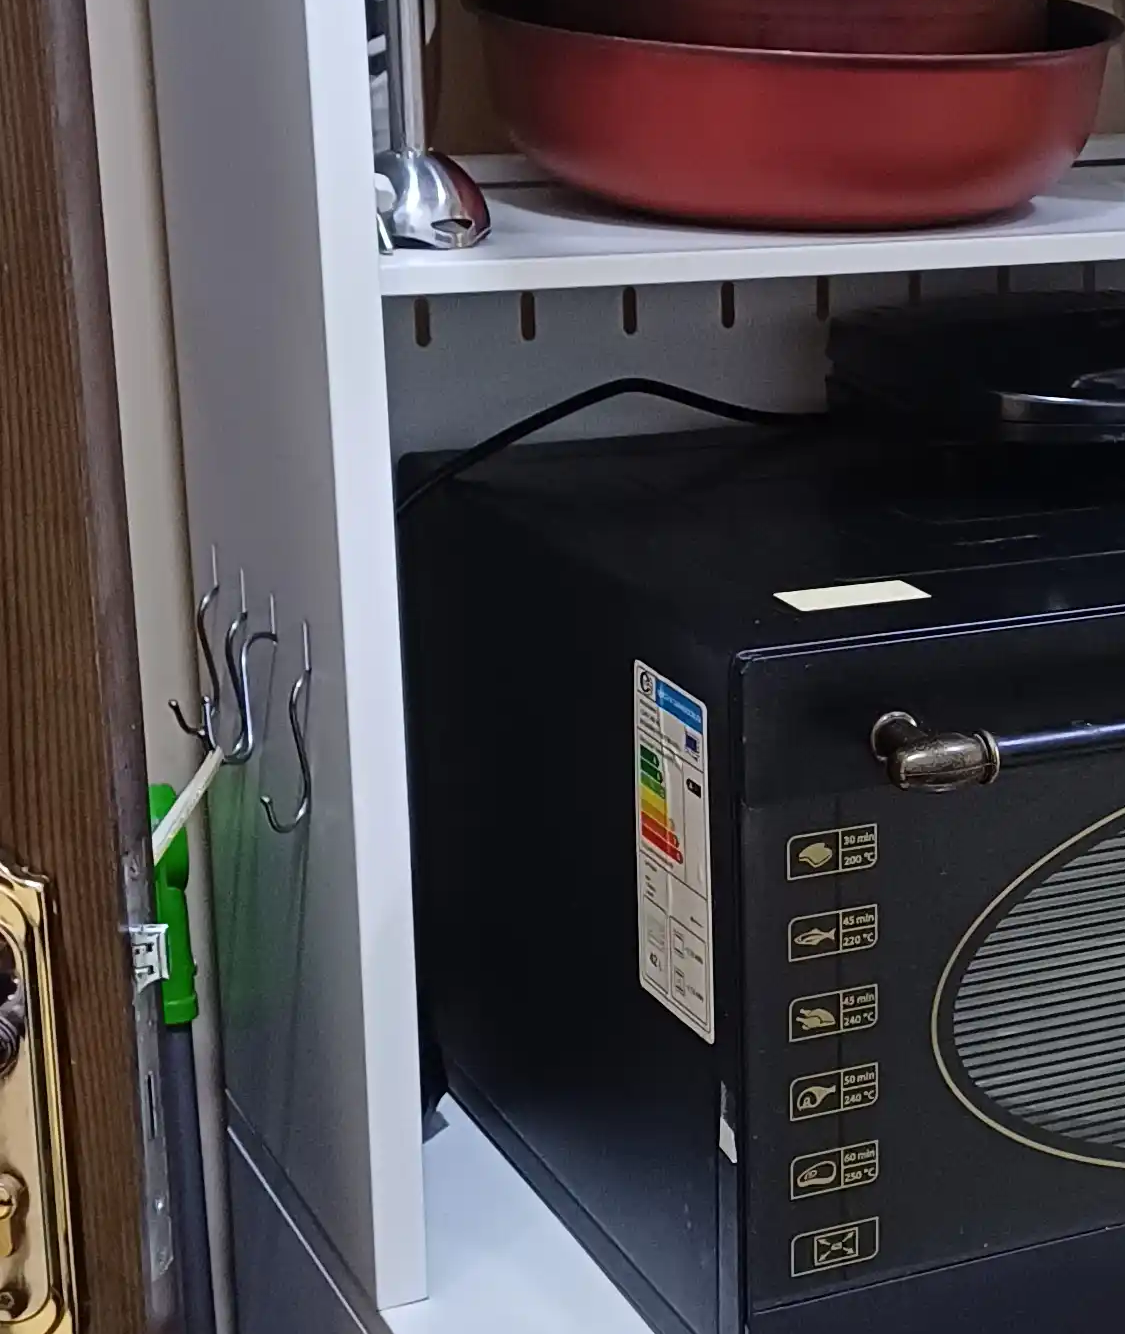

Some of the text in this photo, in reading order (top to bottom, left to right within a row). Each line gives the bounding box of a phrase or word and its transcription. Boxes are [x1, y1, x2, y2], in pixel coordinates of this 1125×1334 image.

[857, 831, 875, 844] min
[843, 854, 862, 866] 200
[856, 912, 875, 925] min
[842, 934, 861, 947] 220
[856, 992, 875, 1004] min
[843, 1071, 875, 1086] 50 min
[857, 1148, 876, 1160] min
